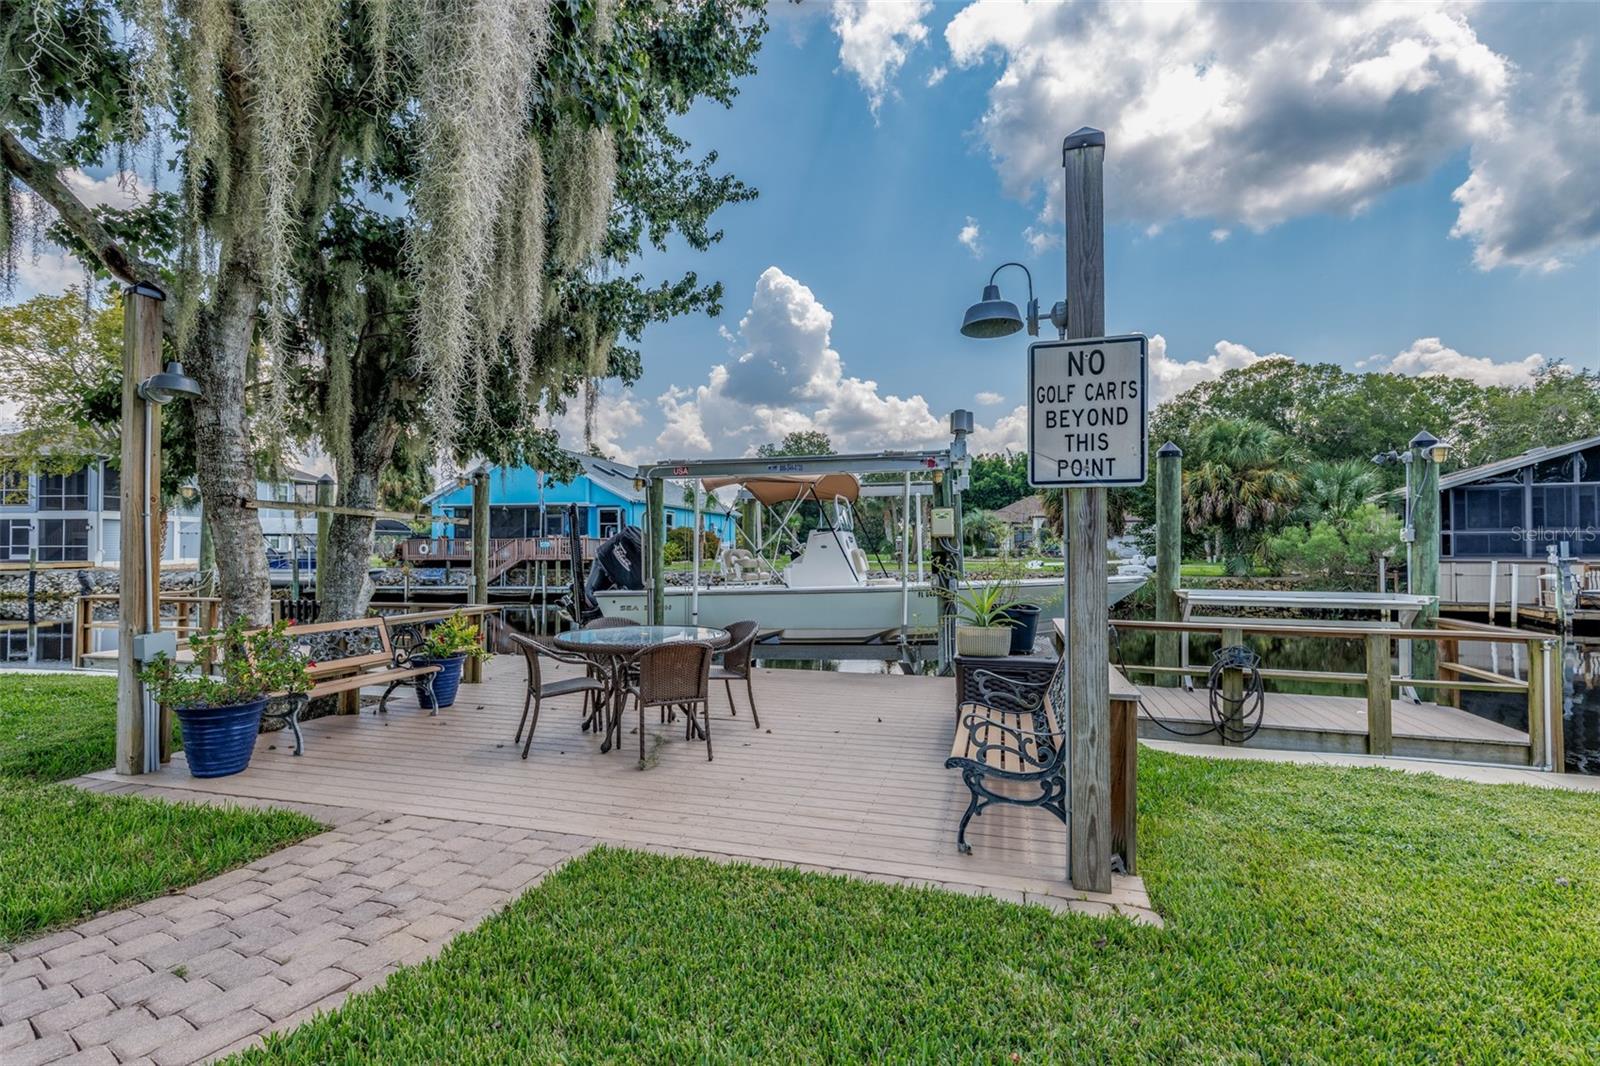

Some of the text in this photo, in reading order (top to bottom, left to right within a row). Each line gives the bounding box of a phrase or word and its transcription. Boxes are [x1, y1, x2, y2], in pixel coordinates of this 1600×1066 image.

[1068, 349, 1105, 377] NO
[1037, 380, 1138, 404] GOLF CARTS
[1046, 407, 1128, 428] BEYOND
[1065, 433, 1109, 452] THIS
[673, 467, 689, 475] USA
[1057, 458, 1116, 478] POINT
